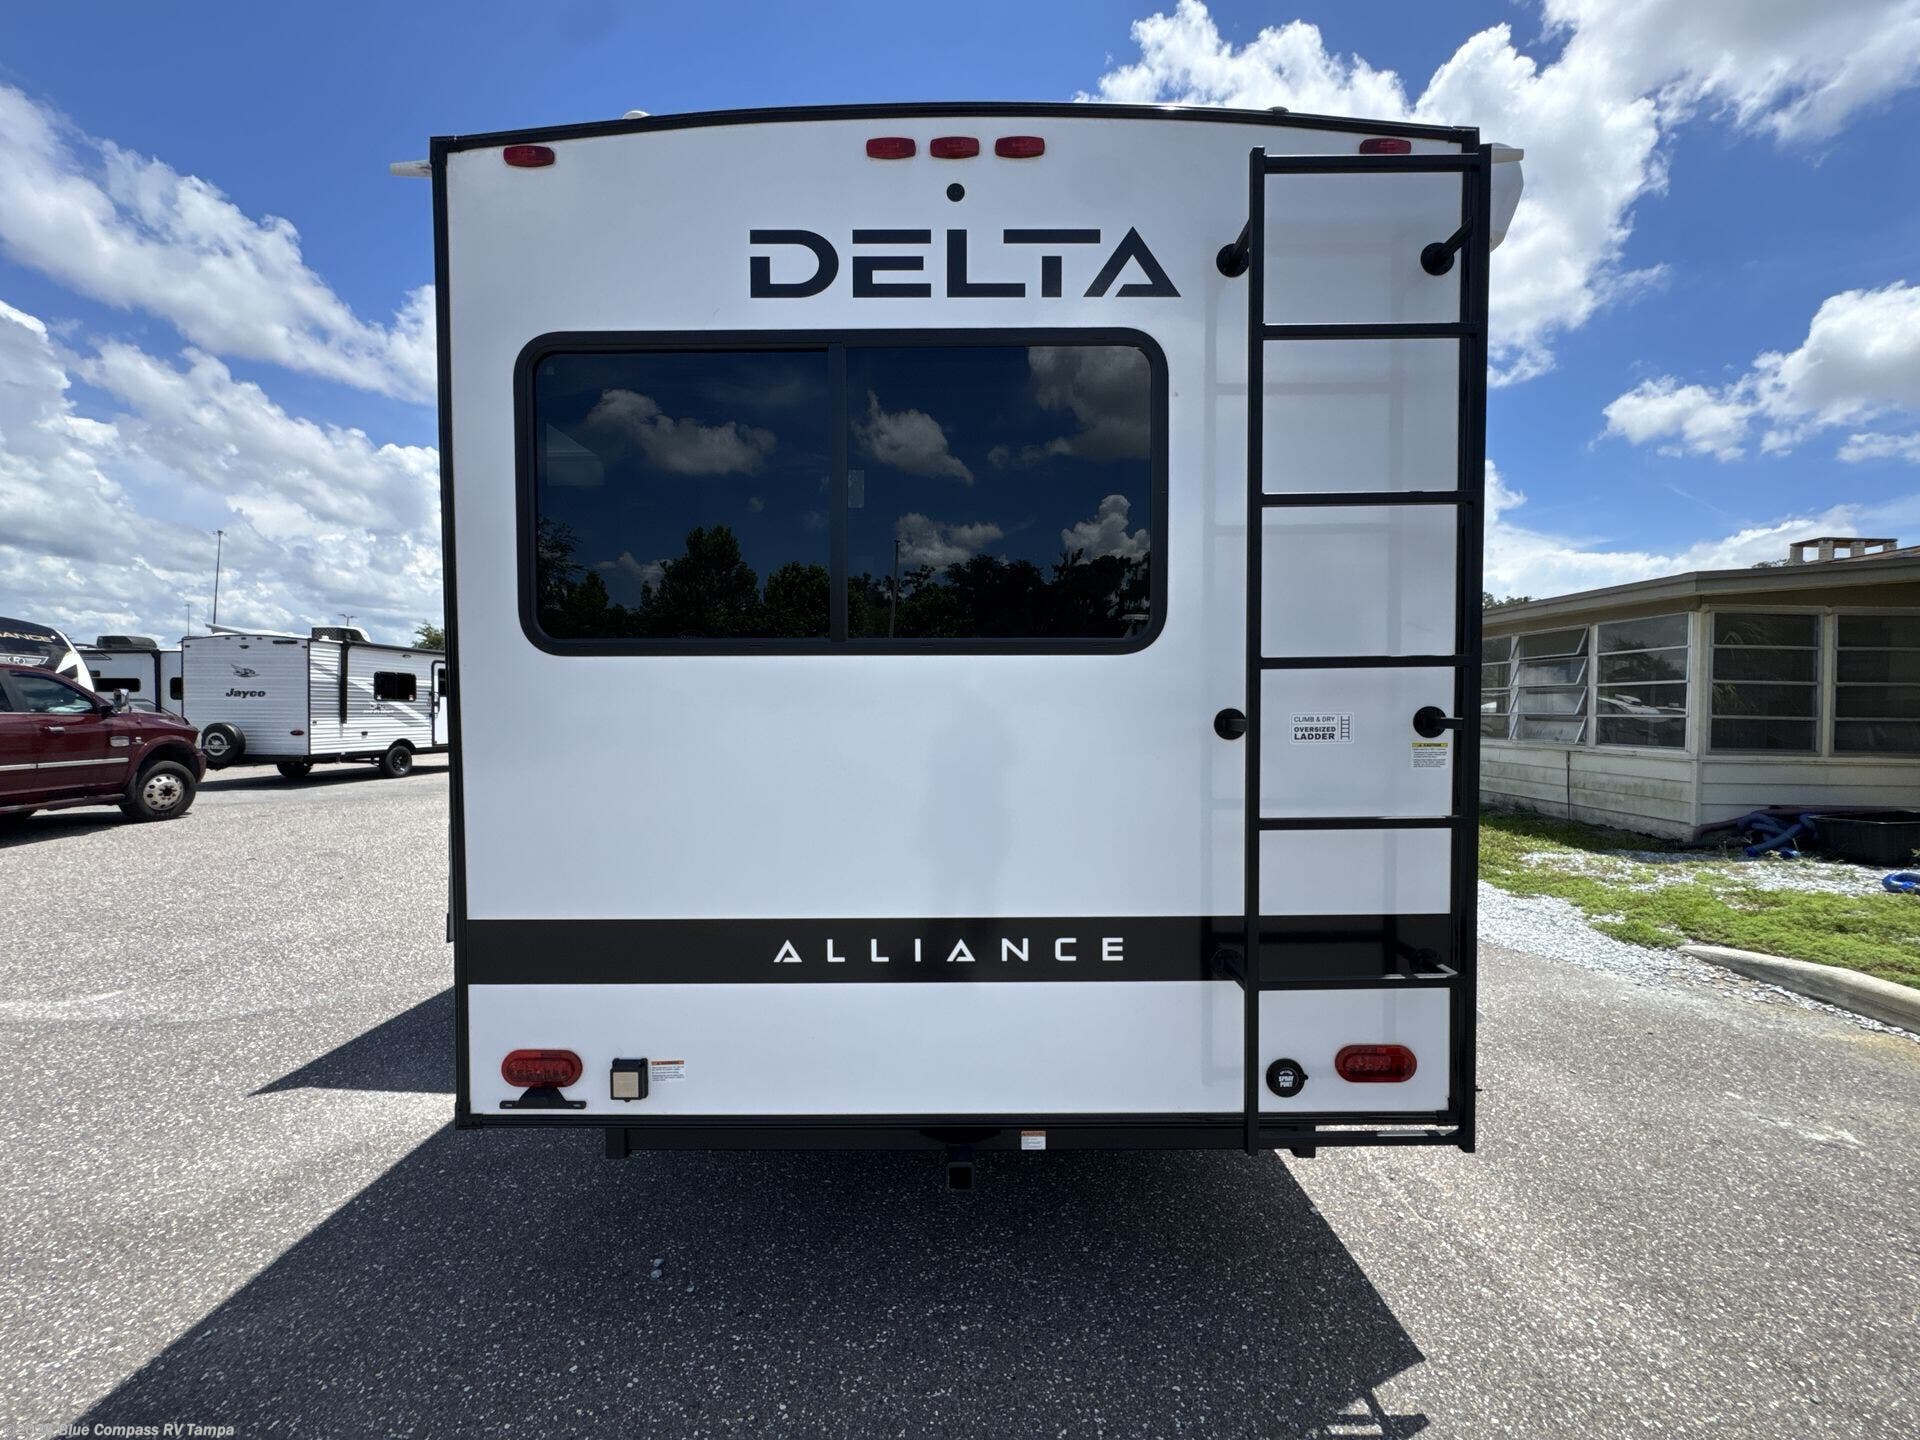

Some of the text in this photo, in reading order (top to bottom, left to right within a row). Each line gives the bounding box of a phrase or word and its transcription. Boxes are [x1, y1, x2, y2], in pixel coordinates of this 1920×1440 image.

[750, 226, 1182, 298] DELTA
[225, 688, 266, 699] Jayco
[1294, 732, 1336, 740] LADDER
[773, 937, 1124, 963] ALLIANCE
